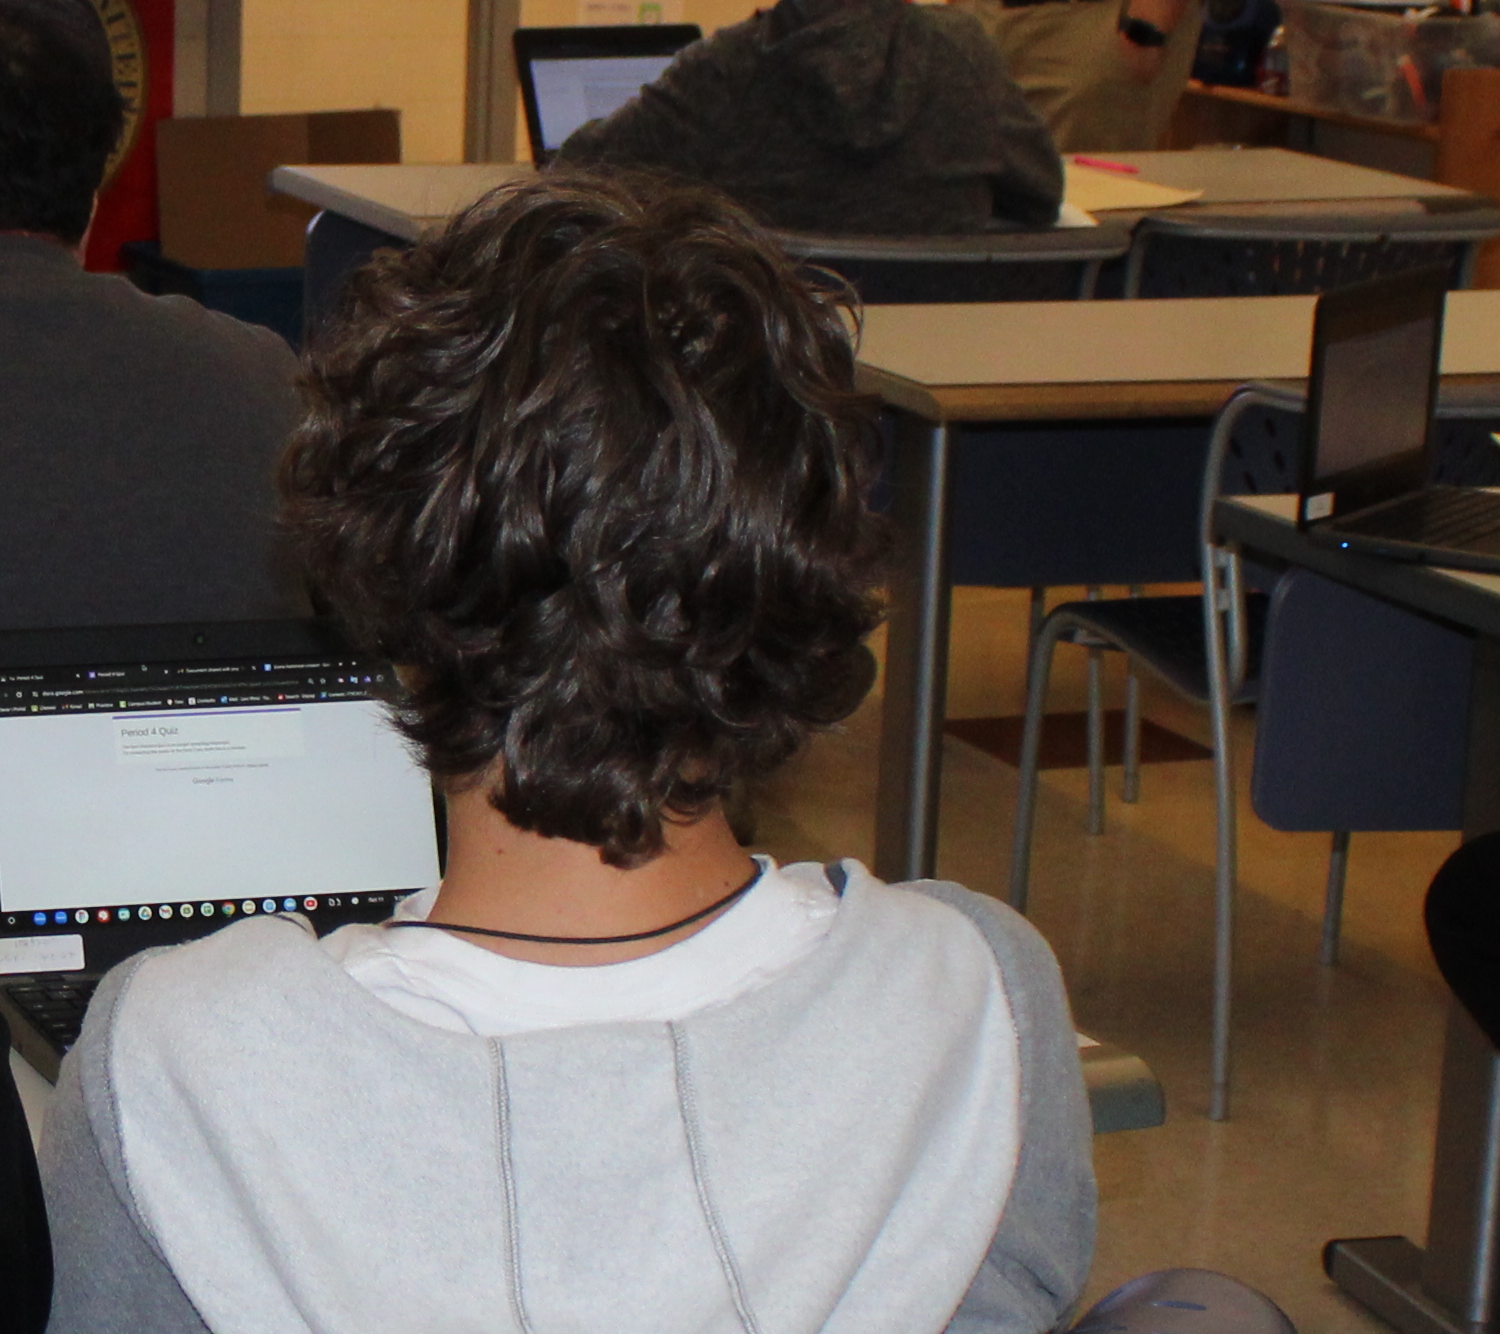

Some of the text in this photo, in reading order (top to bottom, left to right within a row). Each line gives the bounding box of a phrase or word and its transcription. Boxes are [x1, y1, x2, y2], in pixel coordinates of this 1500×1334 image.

[121, 727, 179, 737] Period 4 Quiz
